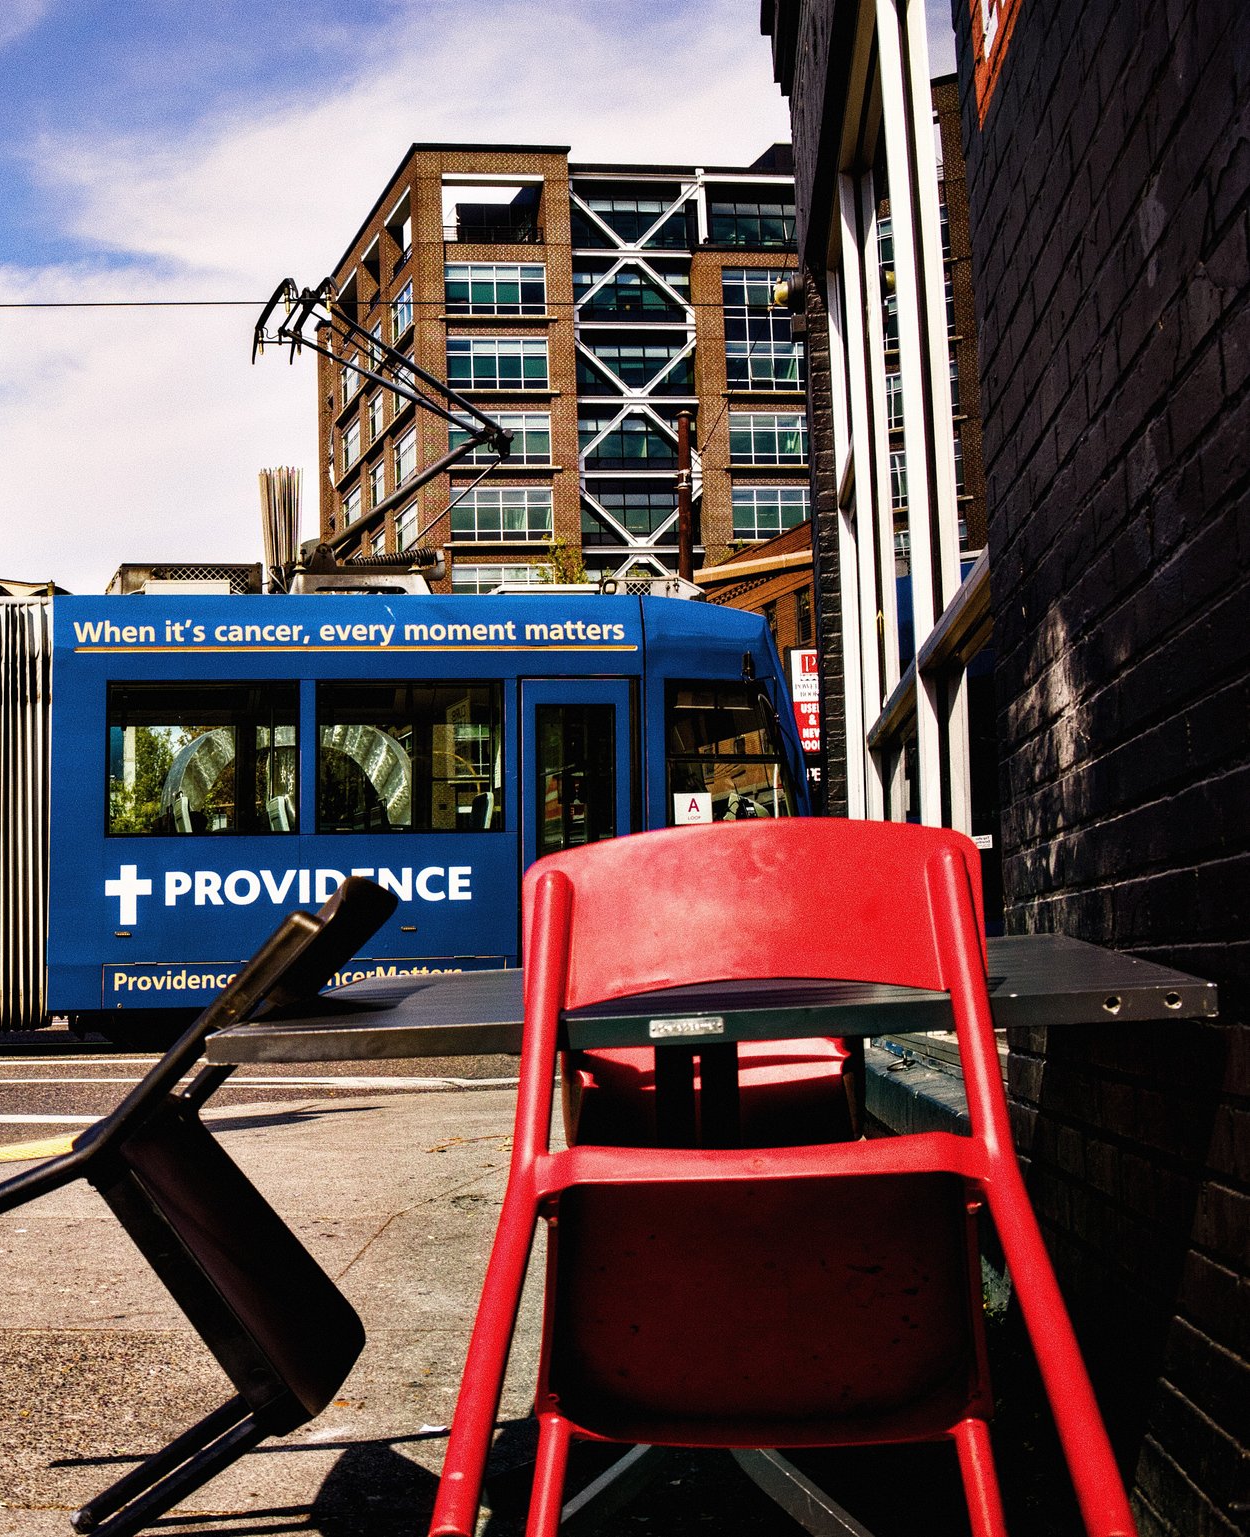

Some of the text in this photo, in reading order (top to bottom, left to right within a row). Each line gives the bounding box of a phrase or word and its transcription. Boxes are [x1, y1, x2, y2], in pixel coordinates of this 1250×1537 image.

[73, 620, 625, 647] When it's cancer, every moment matters
[687, 798, 700, 813] A
[164, 866, 472, 907] PROVIDNCE
